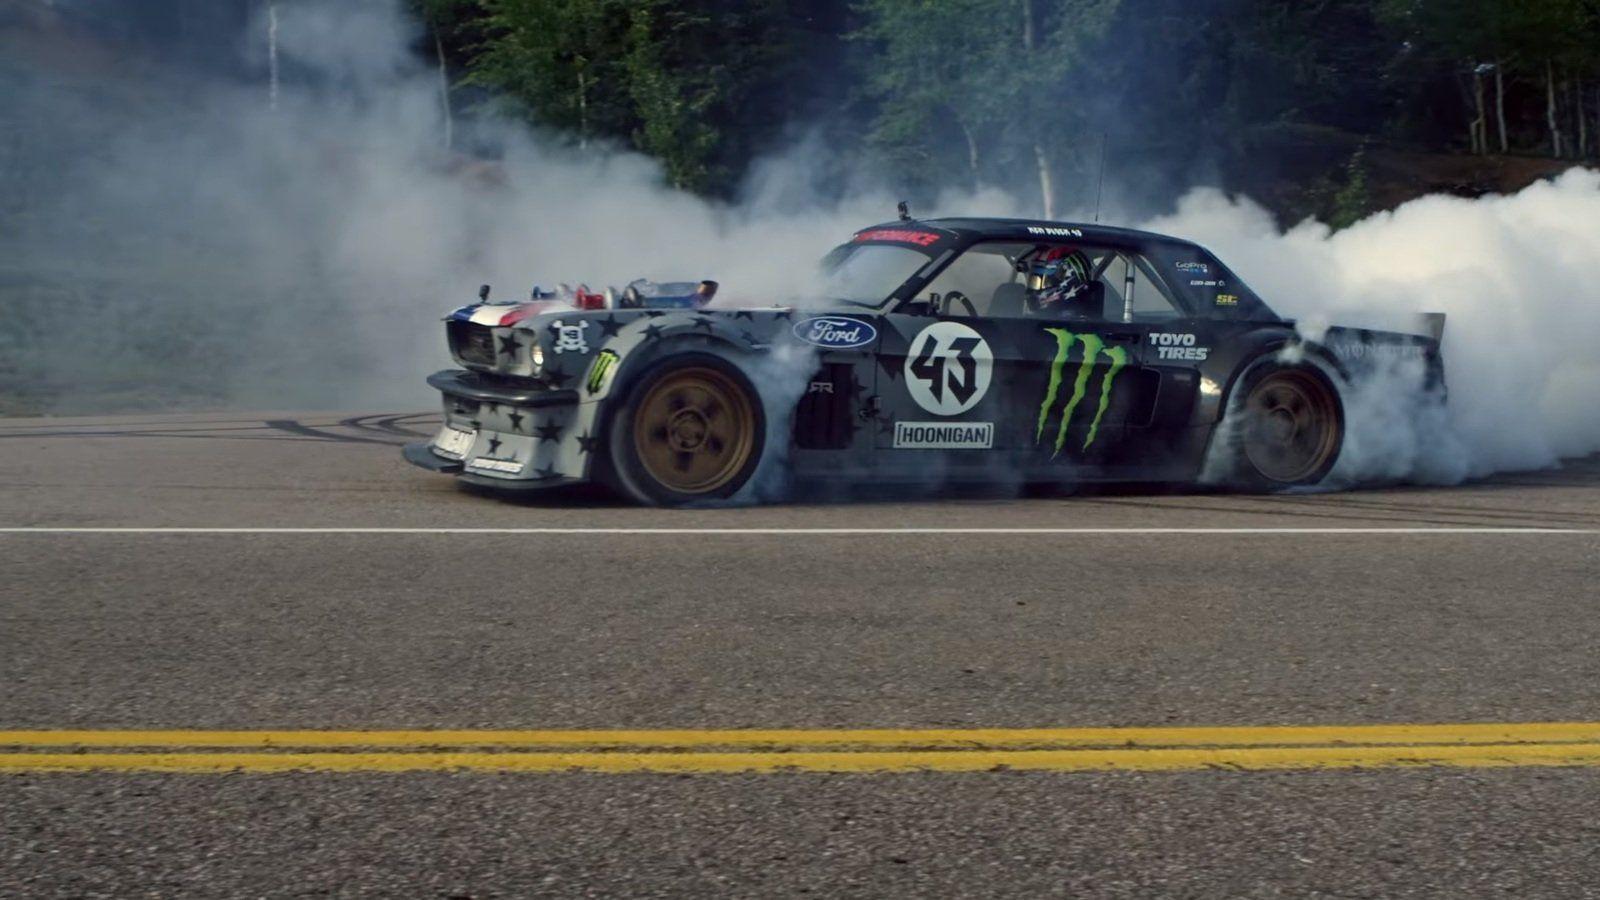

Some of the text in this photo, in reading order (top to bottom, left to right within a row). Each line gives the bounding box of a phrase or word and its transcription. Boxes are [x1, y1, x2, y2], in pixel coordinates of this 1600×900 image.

[1175, 261, 1208, 269] GoPro
[808, 320, 860, 343] Ford
[1149, 333, 1196, 346] TOYO
[1157, 347, 1209, 361] TIRES
[909, 334, 982, 407] 43
